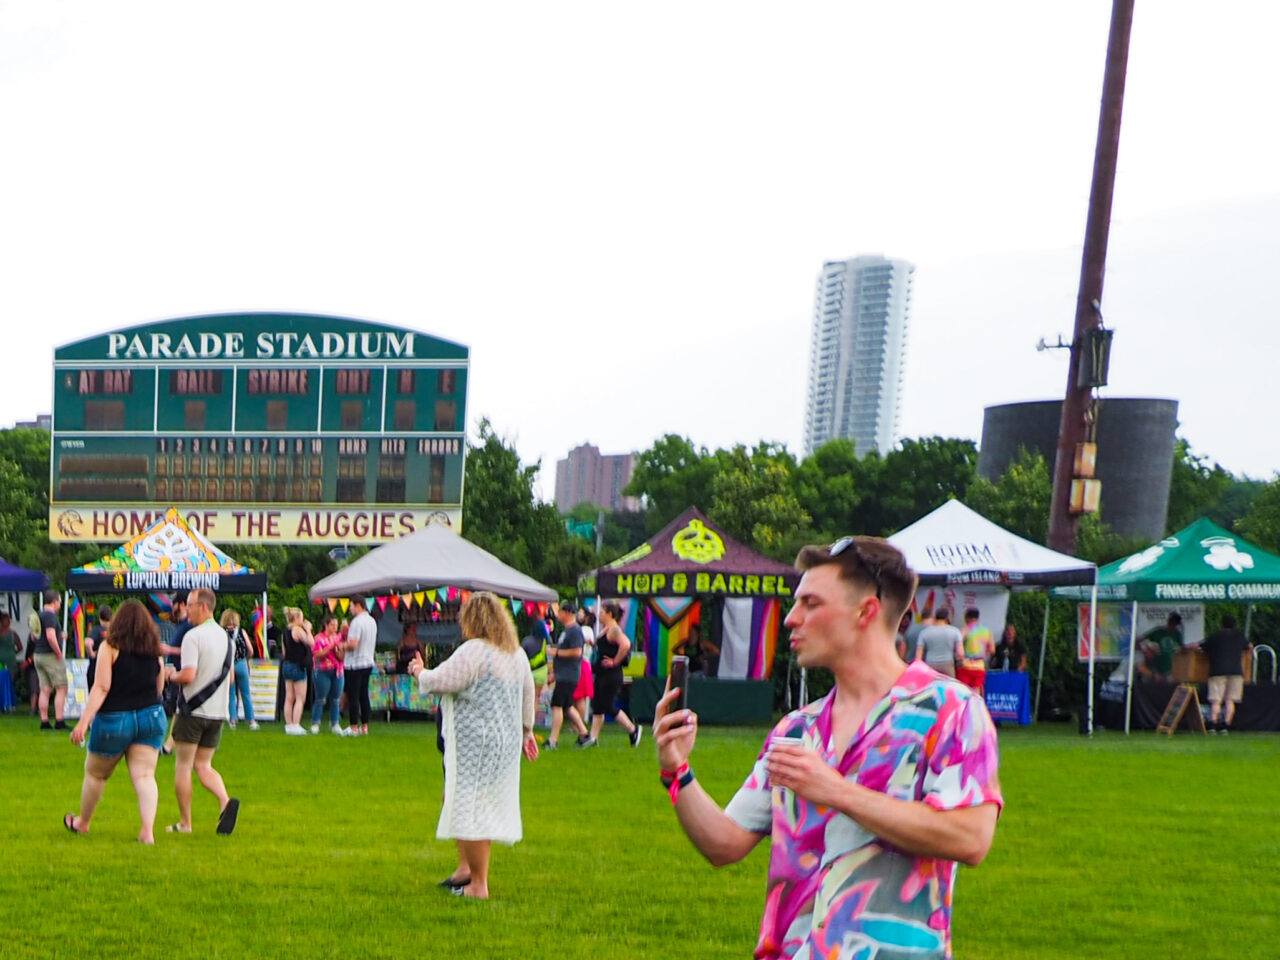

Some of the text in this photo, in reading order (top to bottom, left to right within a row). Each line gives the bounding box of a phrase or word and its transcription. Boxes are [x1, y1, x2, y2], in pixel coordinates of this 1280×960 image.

[108, 331, 416, 358] PARADE STADIUM
[79, 370, 131, 394] AT BAT
[177, 370, 214, 394] BALL
[248, 370, 308, 394] STRIKE
[176, 438, 183, 453] 2
[339, 438, 366, 454] RUNS
[381, 438, 405, 454] HITS
[418, 438, 459, 454] ERRORS
[232, 511, 281, 537] THE
[296, 511, 416, 538] AUGGIES
[127, 571, 219, 590] LUPULIN BREWING
[617, 573, 666, 594] HOP
[696, 572, 791, 595] BARREL
[1156, 583, 1226, 599] FINNEGANS
